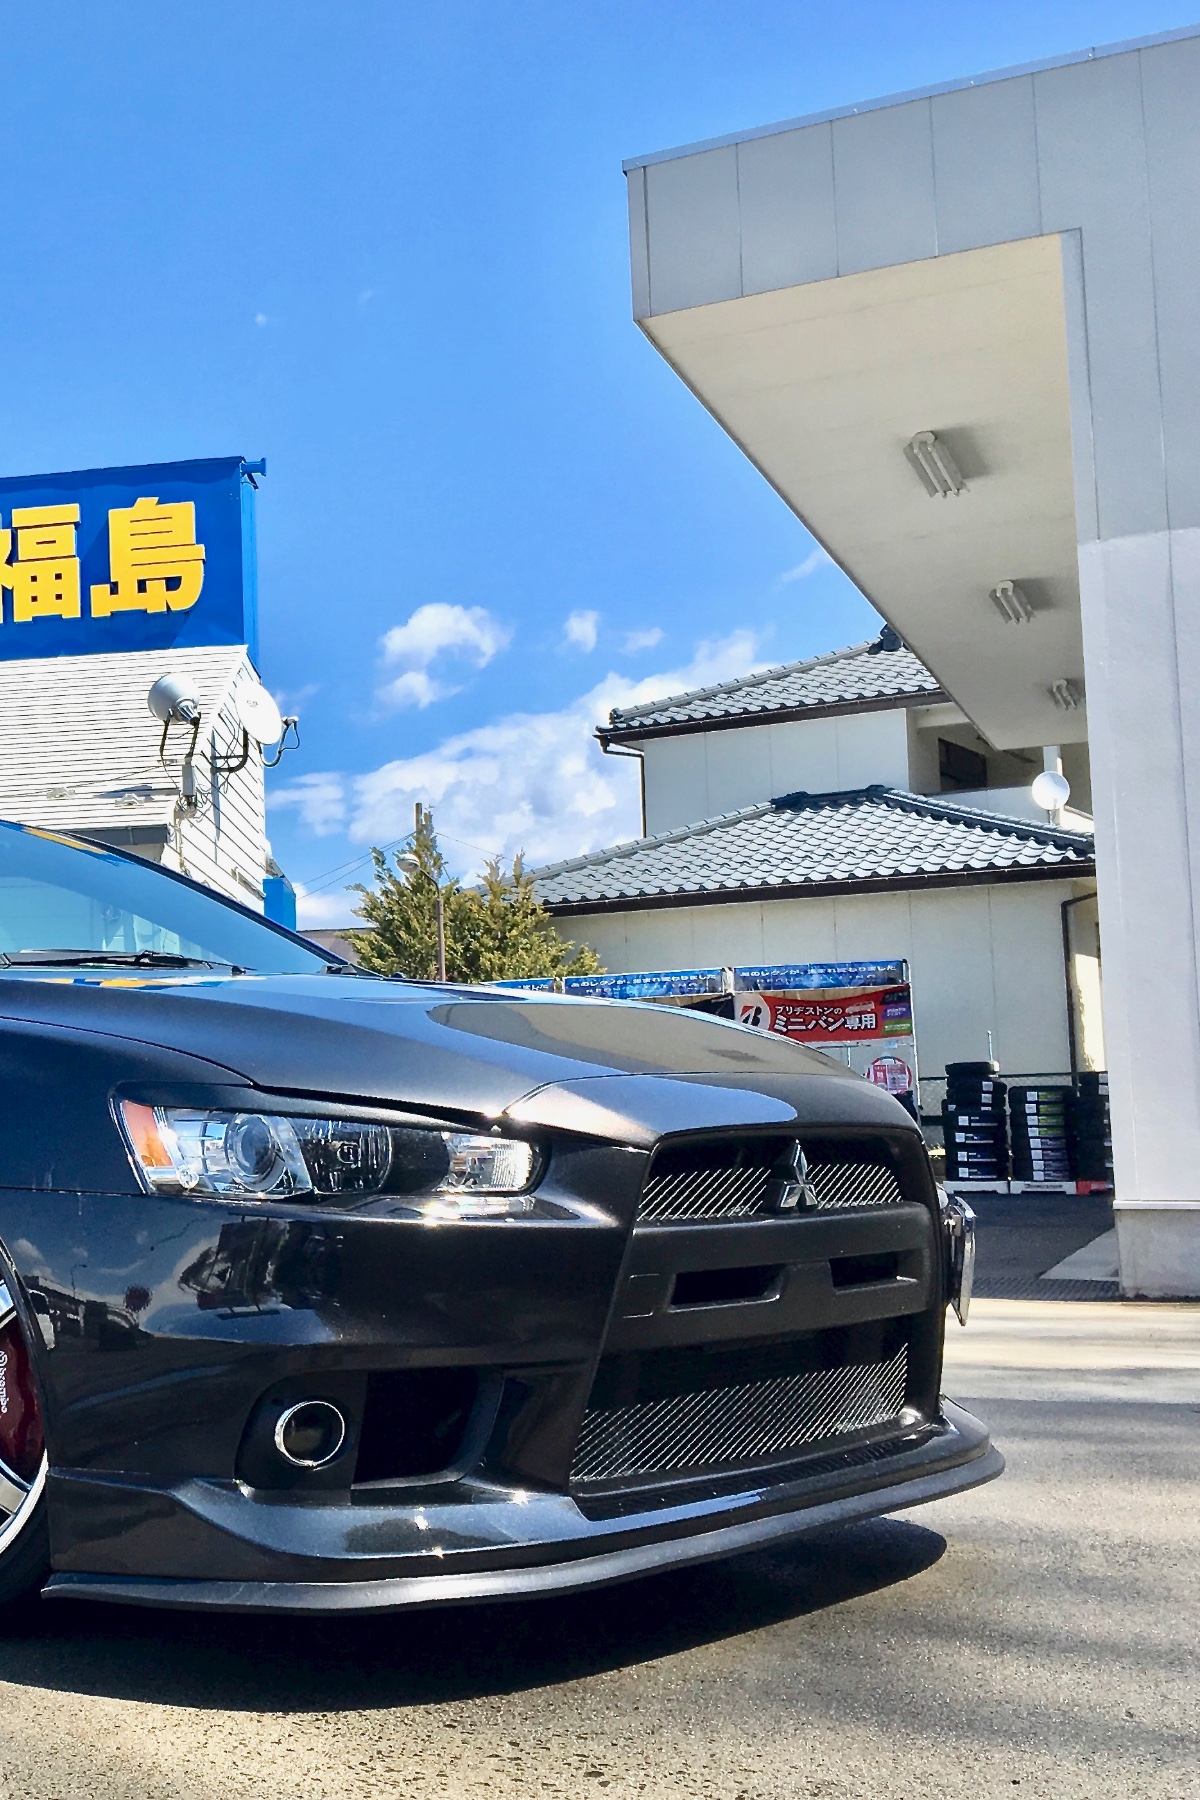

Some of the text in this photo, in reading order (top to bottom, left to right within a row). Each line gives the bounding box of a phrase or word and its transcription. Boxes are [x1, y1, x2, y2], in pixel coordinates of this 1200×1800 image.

[774, 1013, 876, 1032] ミニバン専用
